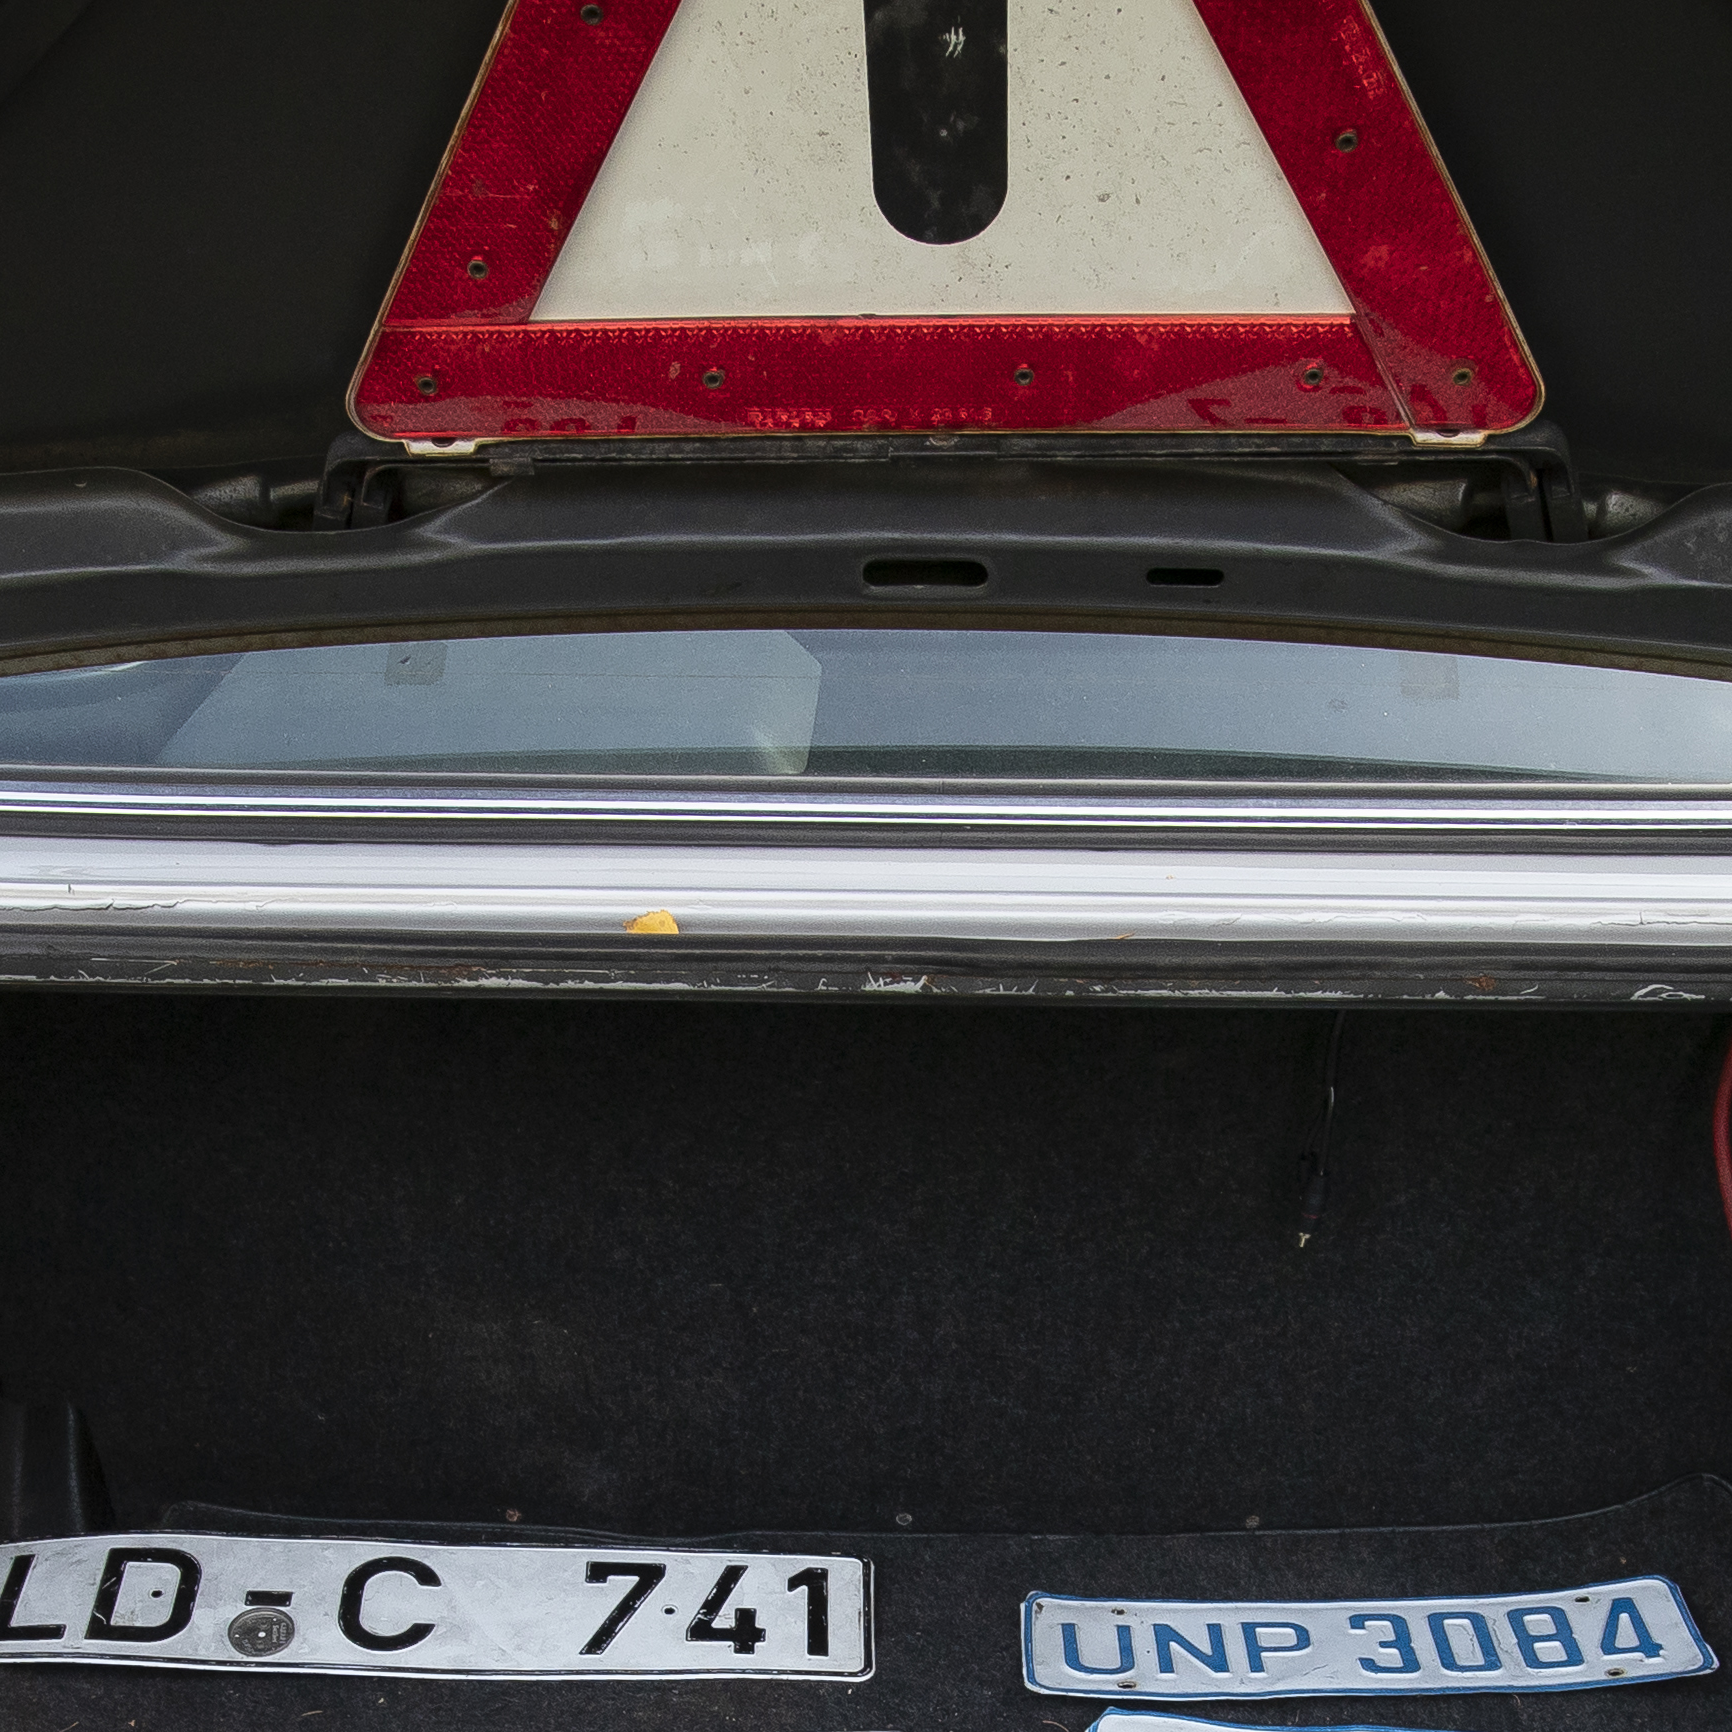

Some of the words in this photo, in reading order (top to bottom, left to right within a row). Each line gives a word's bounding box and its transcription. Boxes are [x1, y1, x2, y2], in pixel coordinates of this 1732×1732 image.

[579, 1560, 832, 1657] 741
[1061, 1620, 1311, 1676] UNP
[1348, 1596, 1664, 1674] 3084
